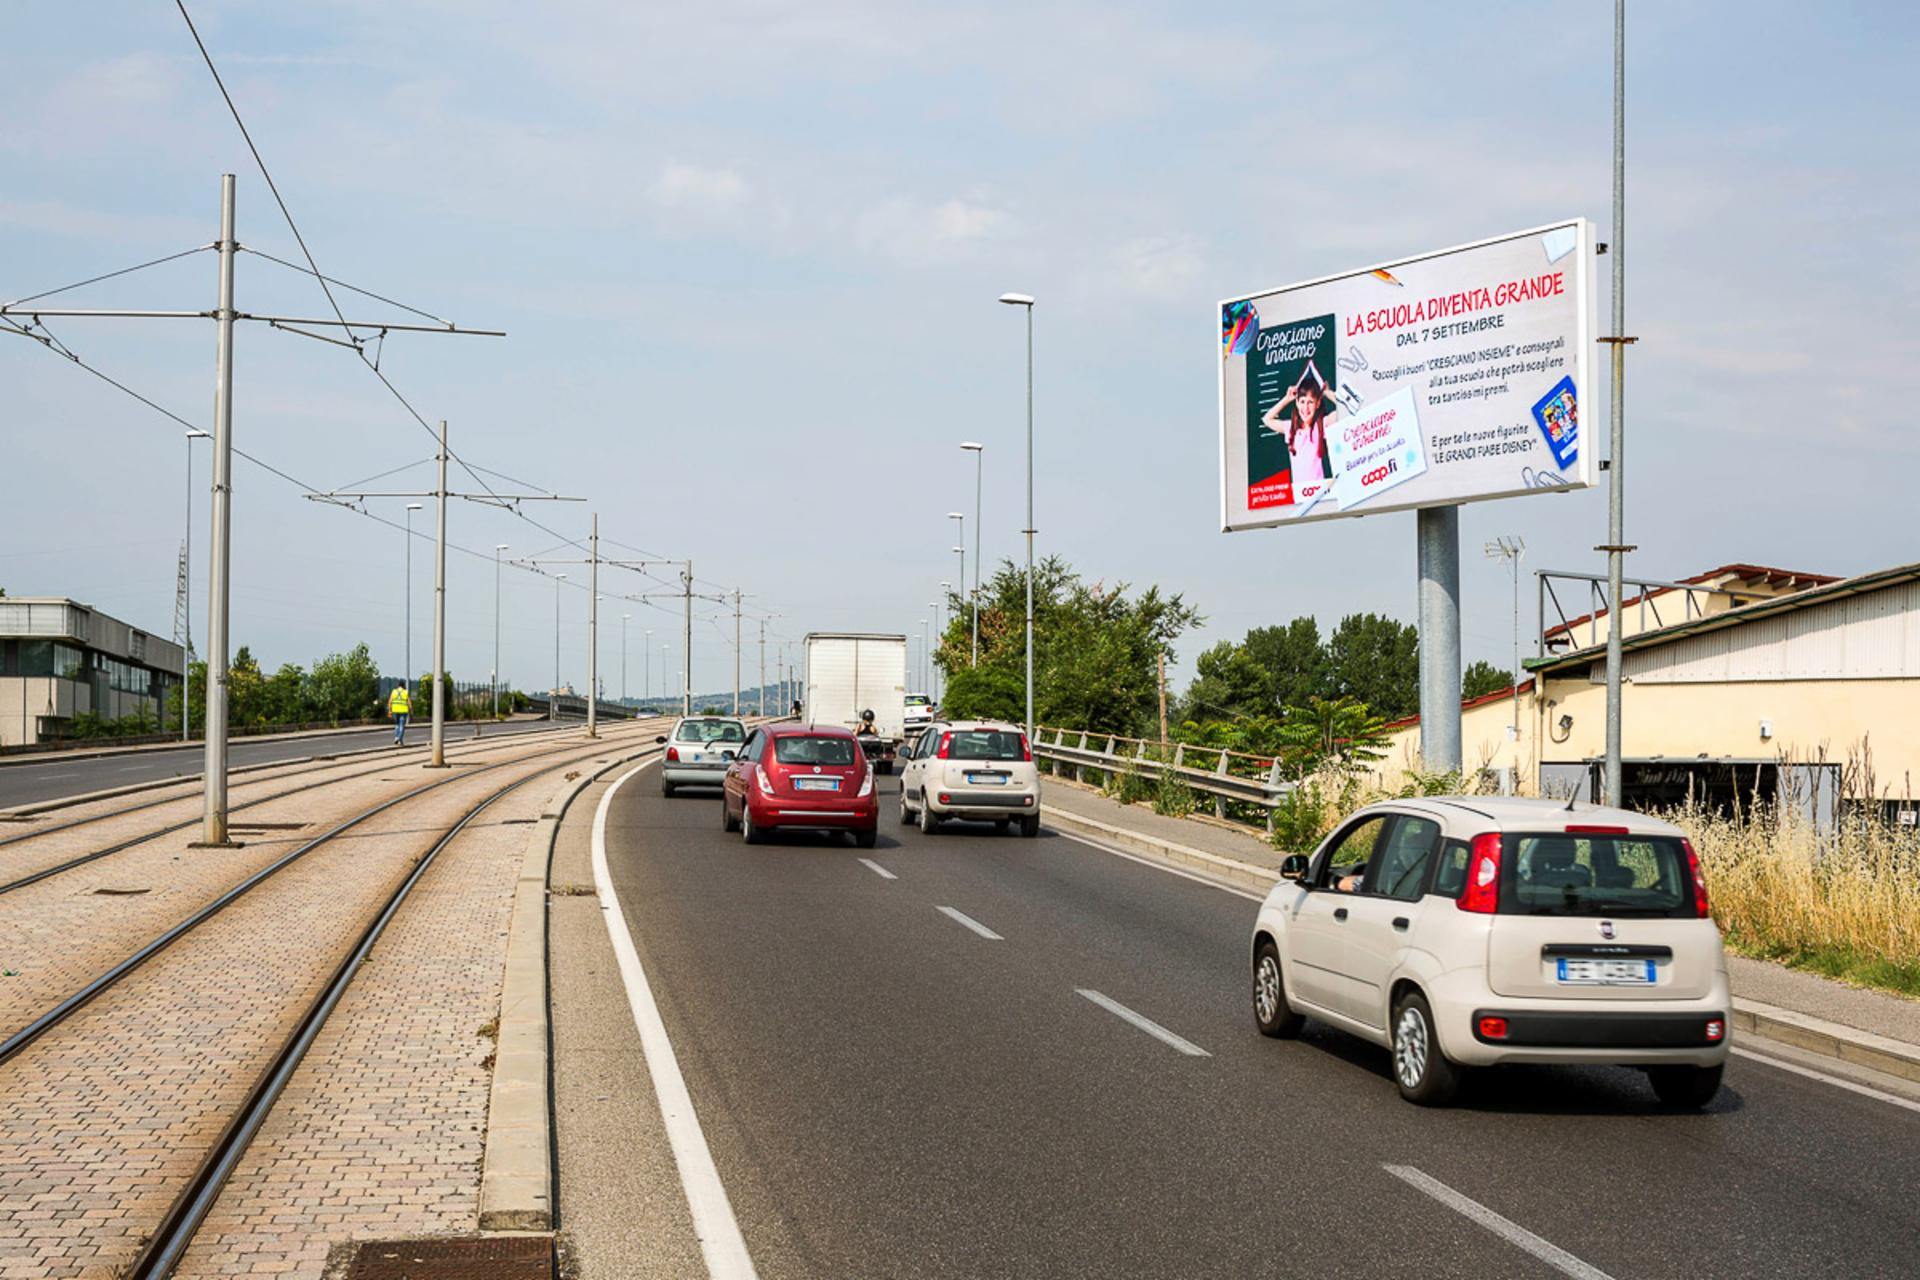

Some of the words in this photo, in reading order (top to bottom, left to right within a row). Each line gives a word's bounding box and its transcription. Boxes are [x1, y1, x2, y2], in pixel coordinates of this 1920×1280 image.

[1346, 314, 1364, 337] LA
[1367, 301, 1425, 333] SCUOLA
[1428, 287, 1492, 321] DIVENTA
[1495, 272, 1564, 307] GRANDE
[1257, 324, 1325, 351] Cresciamo
[1396, 332, 1418, 347] DAL
[1421, 328, 1430, 342] 7
[1432, 314, 1504, 340] SETTEMBRE
[1265, 342, 1316, 365] insieme
[1460, 368, 1484, 383] scuola
[1486, 366, 1500, 378] che
[1526, 356, 1564, 372] scegliere
[1432, 436, 1438, 447] E
[1440, 436, 1452, 450] per
[1454, 434, 1462, 444] te
[1464, 432, 1471, 442] le
[1473, 430, 1495, 440] nuove
[1498, 424, 1528, 440] figurine
[1446, 447, 1476, 462] GRANDI
[1478, 443, 1501, 456] FIABE
